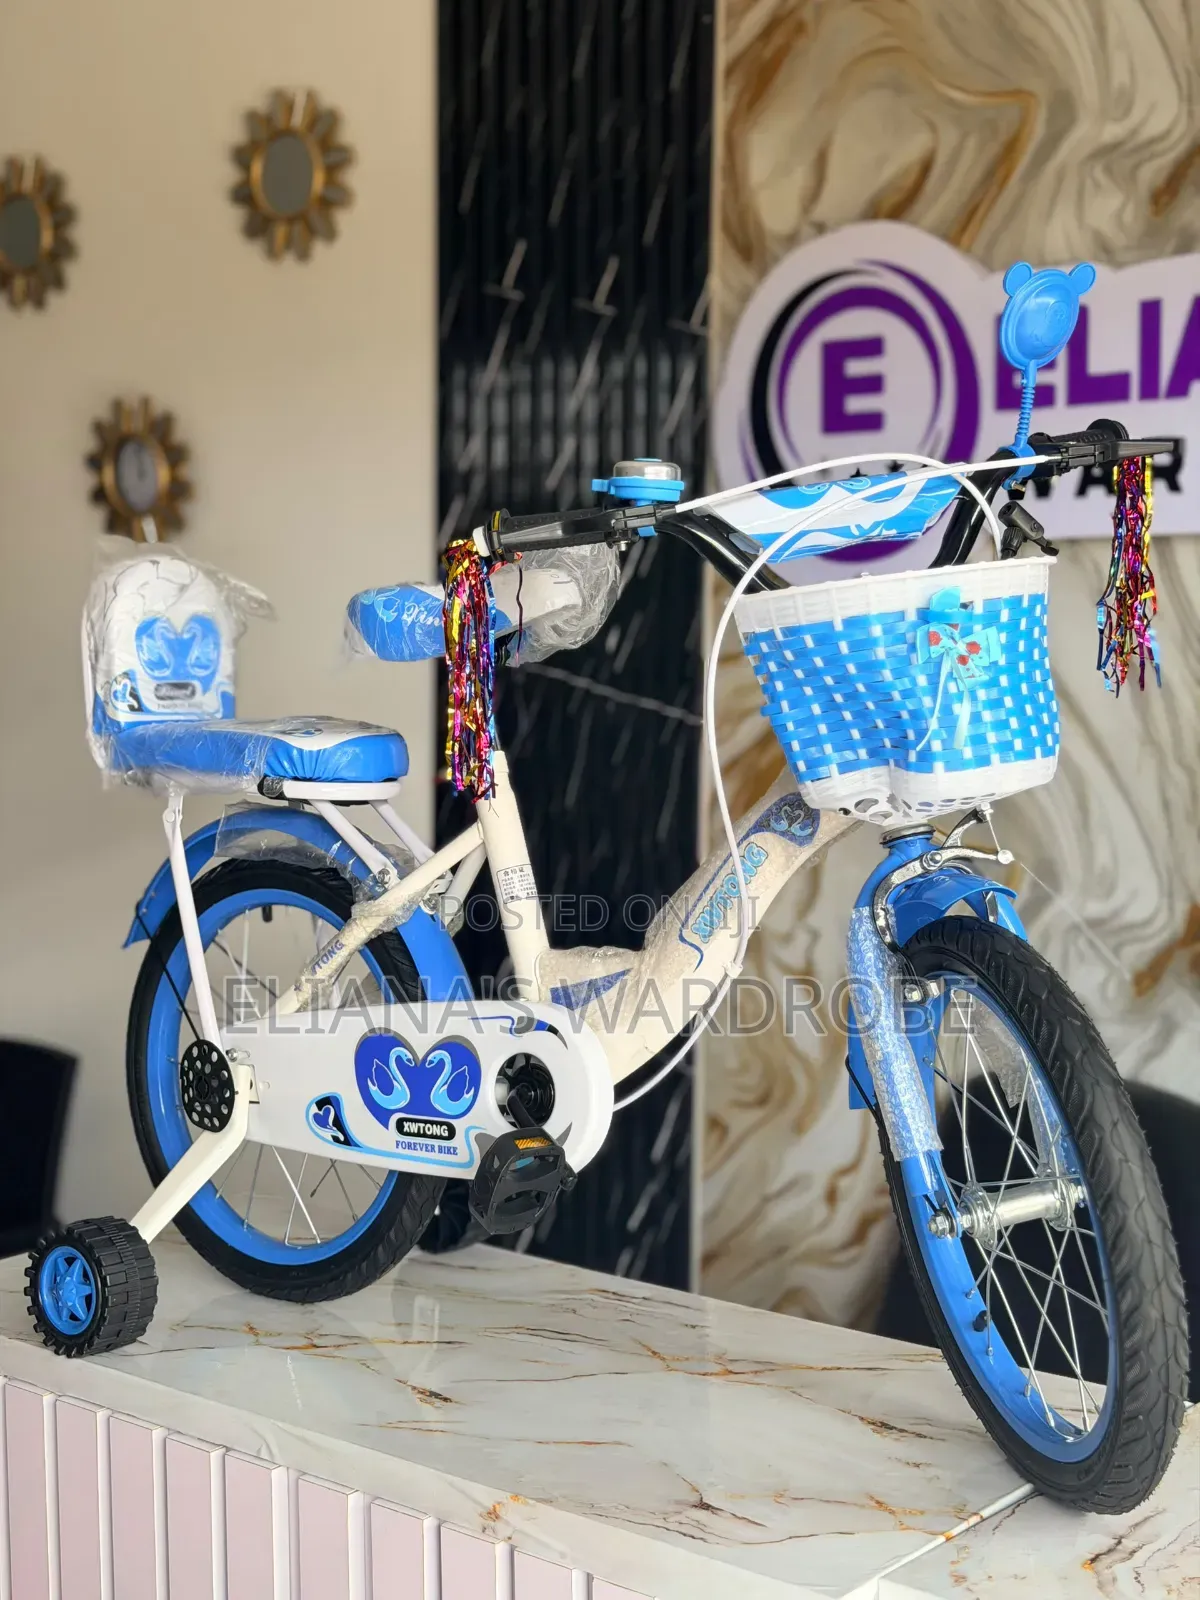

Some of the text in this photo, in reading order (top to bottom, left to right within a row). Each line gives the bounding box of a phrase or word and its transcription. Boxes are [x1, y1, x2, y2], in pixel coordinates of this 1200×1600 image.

[822, 336, 884, 434] E
[402, 1121, 449, 1137] XWTONG
[395, 1140, 458, 1156] FOREVER BIKE
